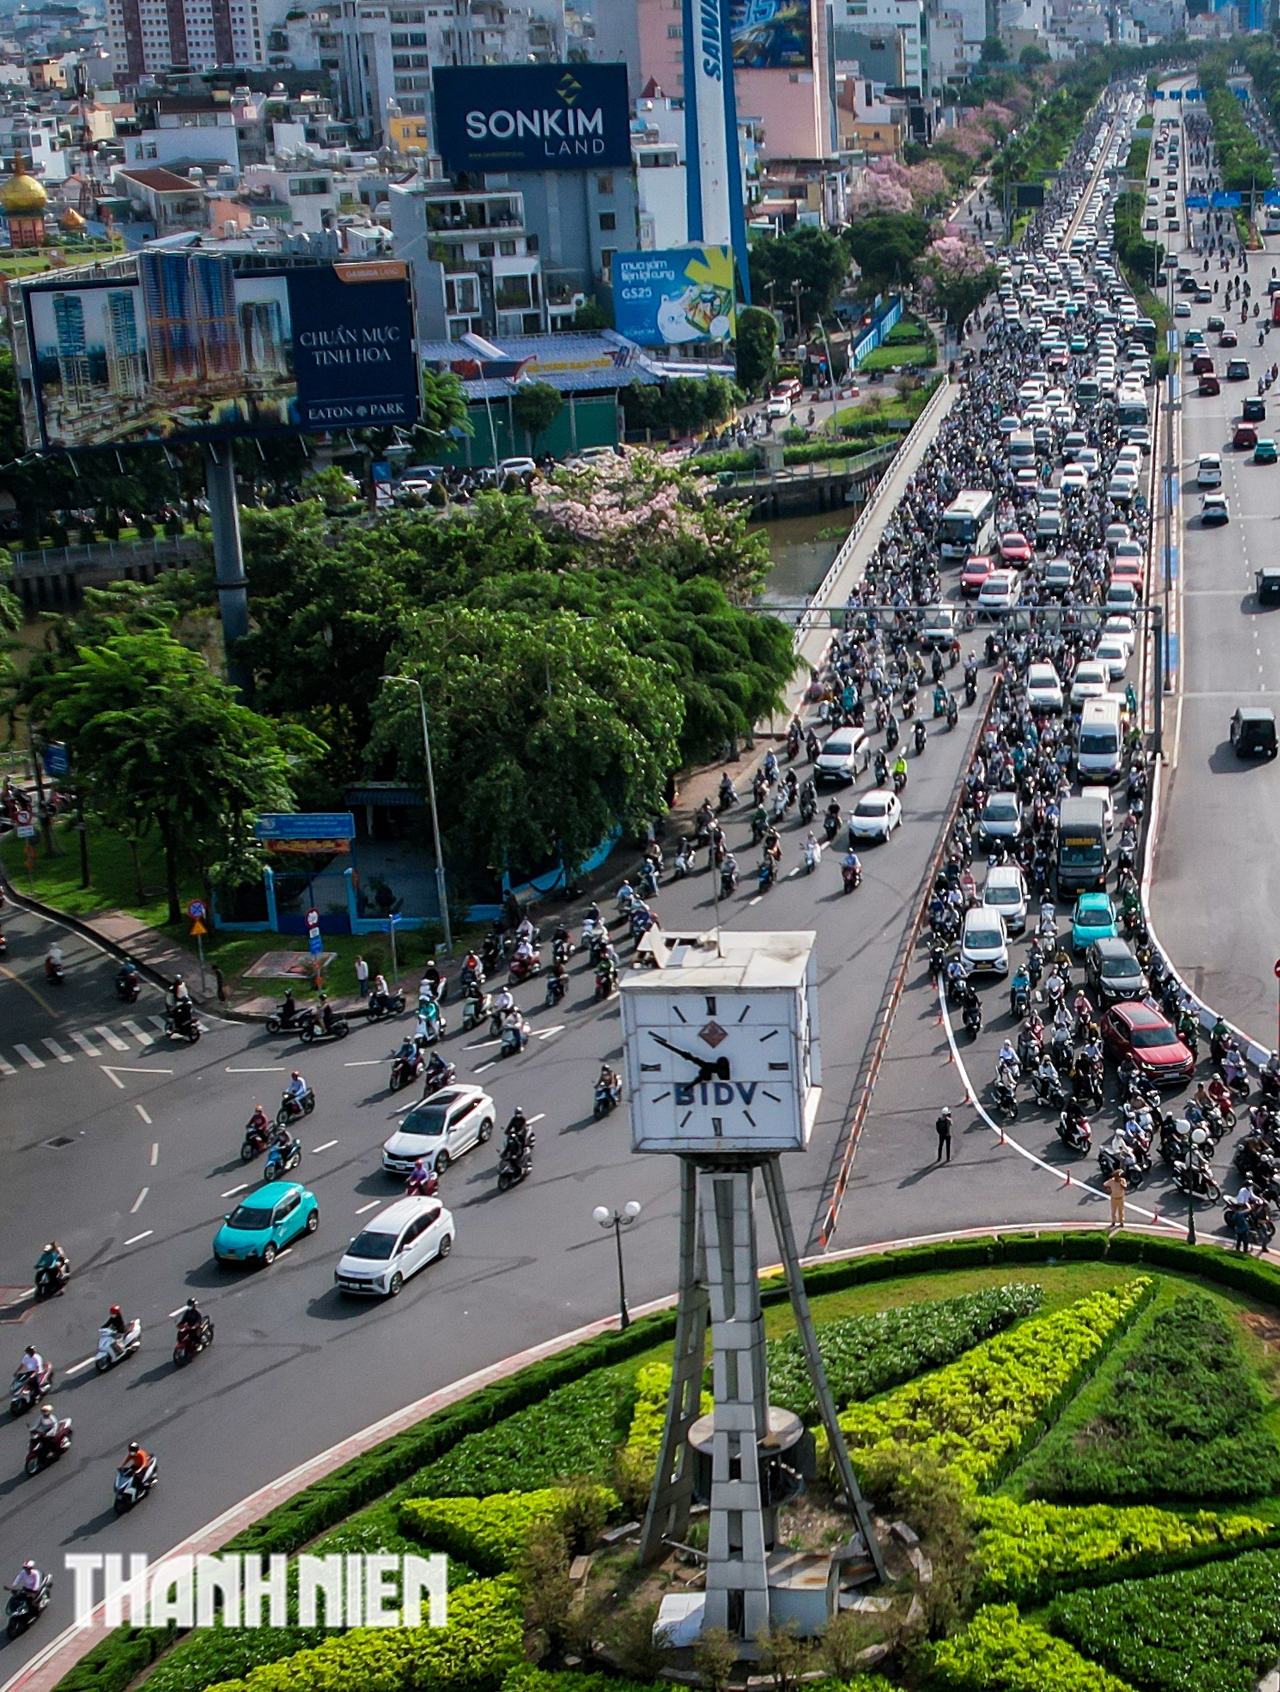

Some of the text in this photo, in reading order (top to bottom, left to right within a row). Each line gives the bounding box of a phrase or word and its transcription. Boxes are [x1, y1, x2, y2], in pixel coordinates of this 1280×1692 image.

[465, 107, 604, 139] SONKIM
[544, 138, 605, 156] LAND
[621, 286, 652, 299] GS25
[300, 325, 400, 346] CHUẨN MỰC
[312, 347, 391, 366] TINH HOA
[308, 402, 405, 420] EATON PARK
[674, 1082, 758, 1106] BIDV
